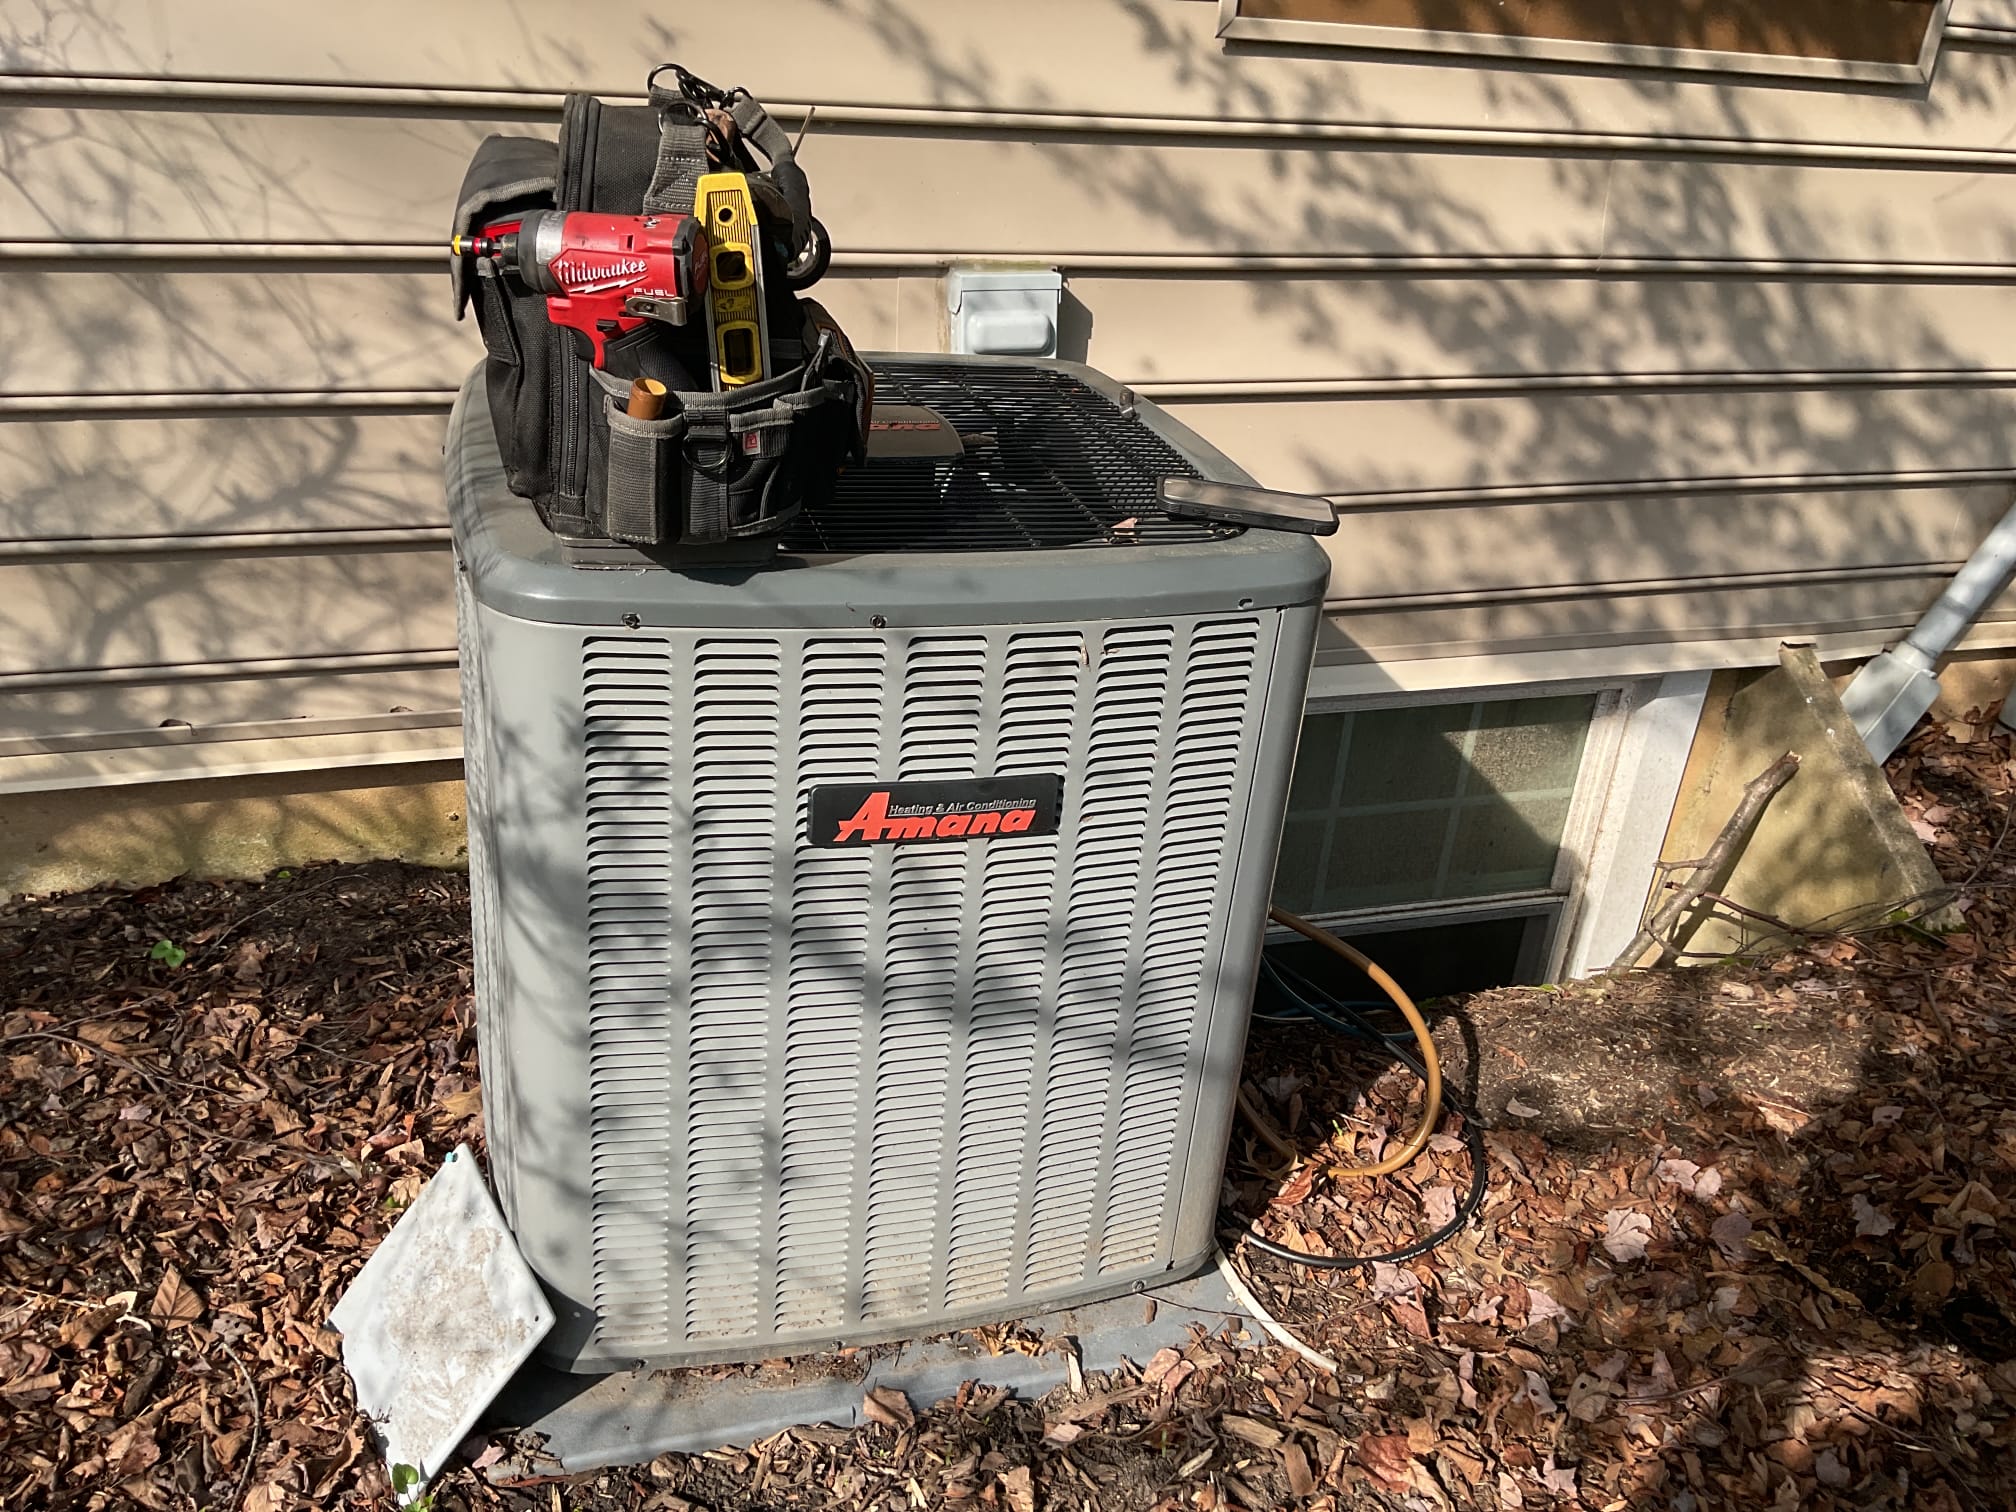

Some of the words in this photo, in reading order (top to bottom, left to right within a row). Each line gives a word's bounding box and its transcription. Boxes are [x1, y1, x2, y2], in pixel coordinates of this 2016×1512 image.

[557, 258, 648, 285] Milwaukee
[633, 287, 675, 297] FUEL
[869, 423, 940, 431] ana
[889, 804, 934, 816] Heating
[935, 803, 945, 813] &
[945, 802, 965, 812] Air
[966, 798, 1037, 811] Conditioning
[833, 791, 1037, 842] Amana
